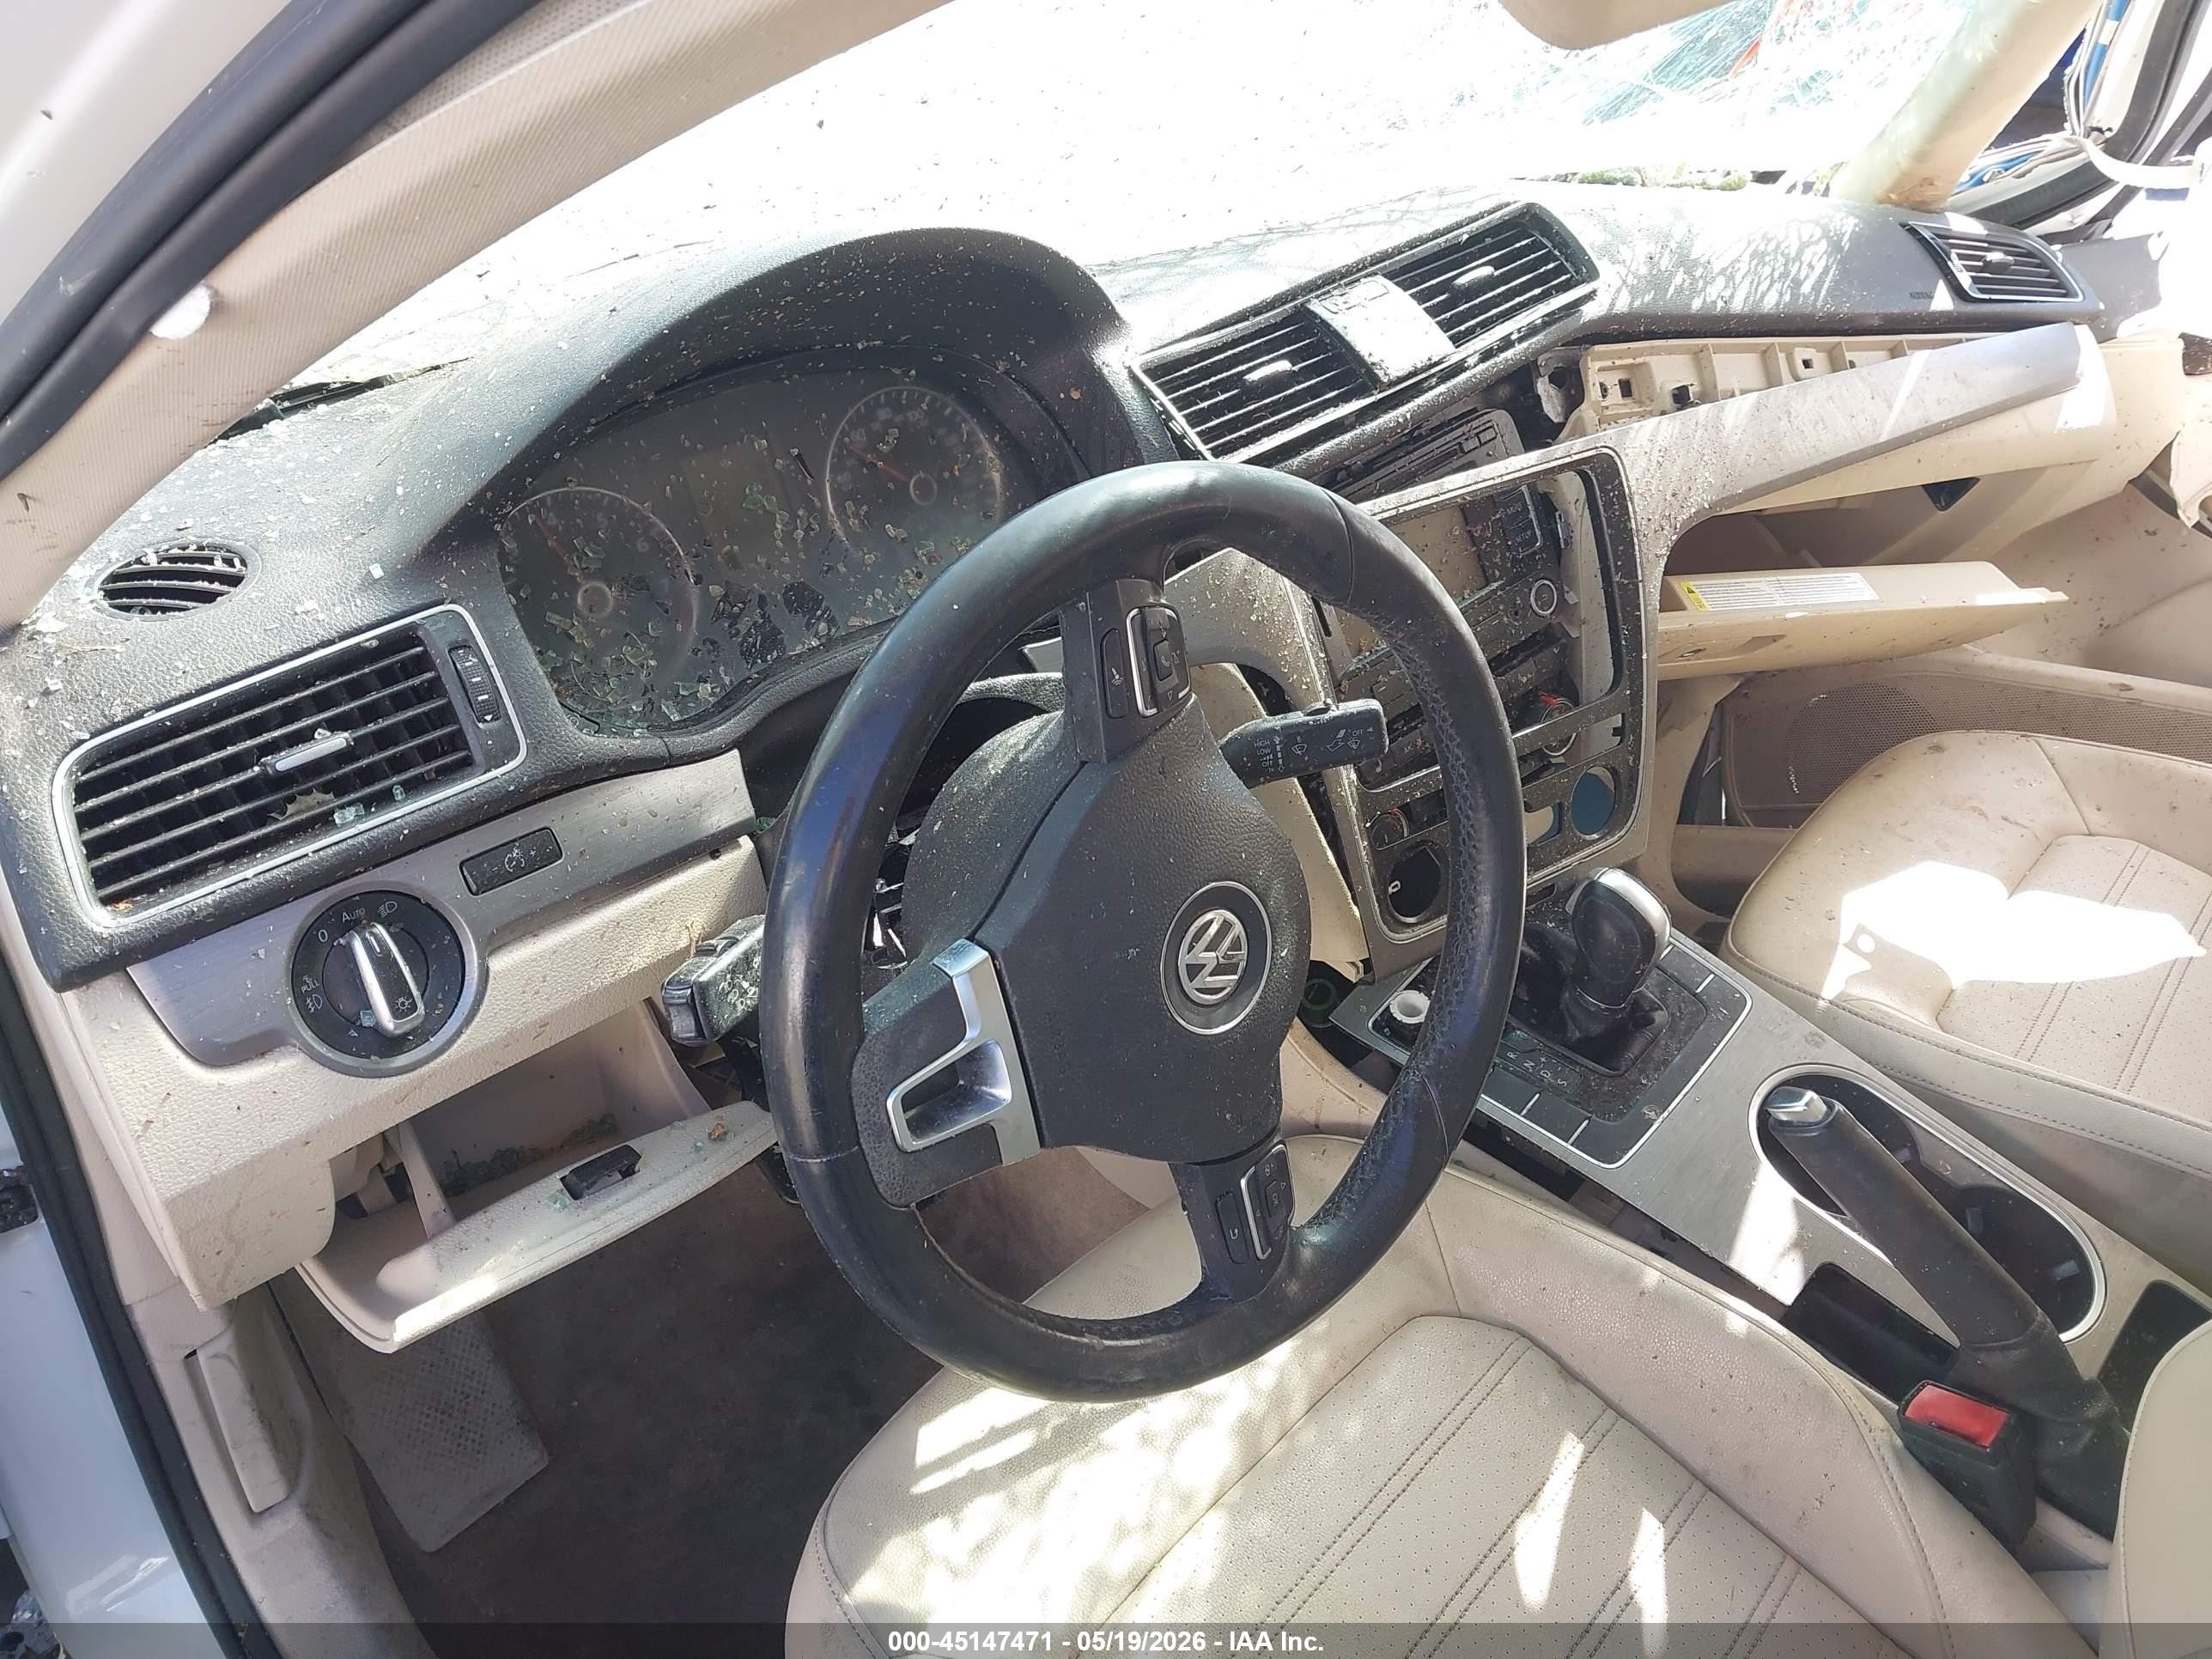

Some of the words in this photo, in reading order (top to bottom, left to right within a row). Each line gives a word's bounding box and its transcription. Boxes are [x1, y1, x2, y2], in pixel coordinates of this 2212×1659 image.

[1253, 739, 1270, 748] HIGH
[1256, 746, 1272, 756] LOW
[301, 979, 320, 994] PULL
[1506, 1051, 1518, 1060] R
[1523, 1059, 1535, 1070] N
[1540, 1069, 1551, 1079] D
[1557, 1079, 1567, 1087] S
